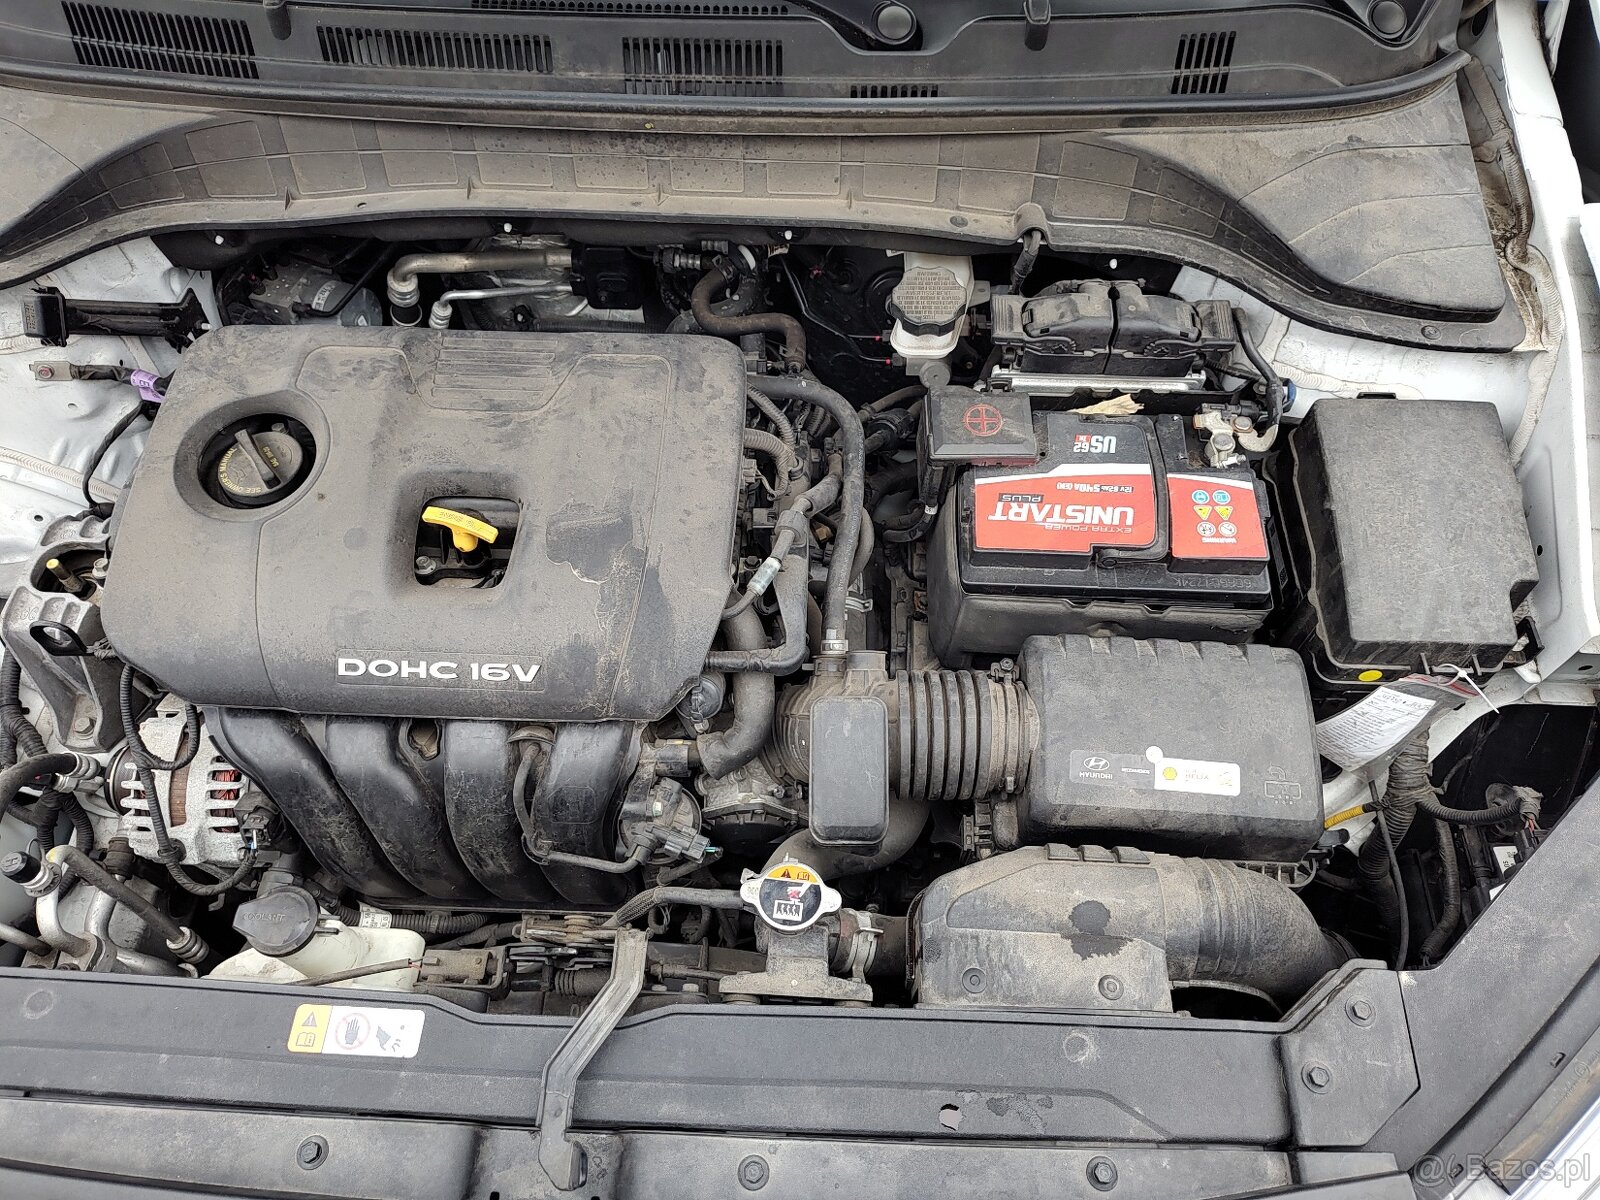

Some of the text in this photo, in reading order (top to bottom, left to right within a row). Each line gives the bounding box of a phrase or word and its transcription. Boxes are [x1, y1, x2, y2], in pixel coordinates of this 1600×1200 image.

[245, 486, 262, 494] SEE
[1001, 494, 1042, 502] PLUS
[987, 501, 1135, 525] UNISTART
[1044, 523, 1132, 533] EXTRA POWER
[337, 657, 541, 683] DOHC 16V
[1079, 771, 1113, 780] HYUNDAI
[243, 912, 286, 922] COOLANT
